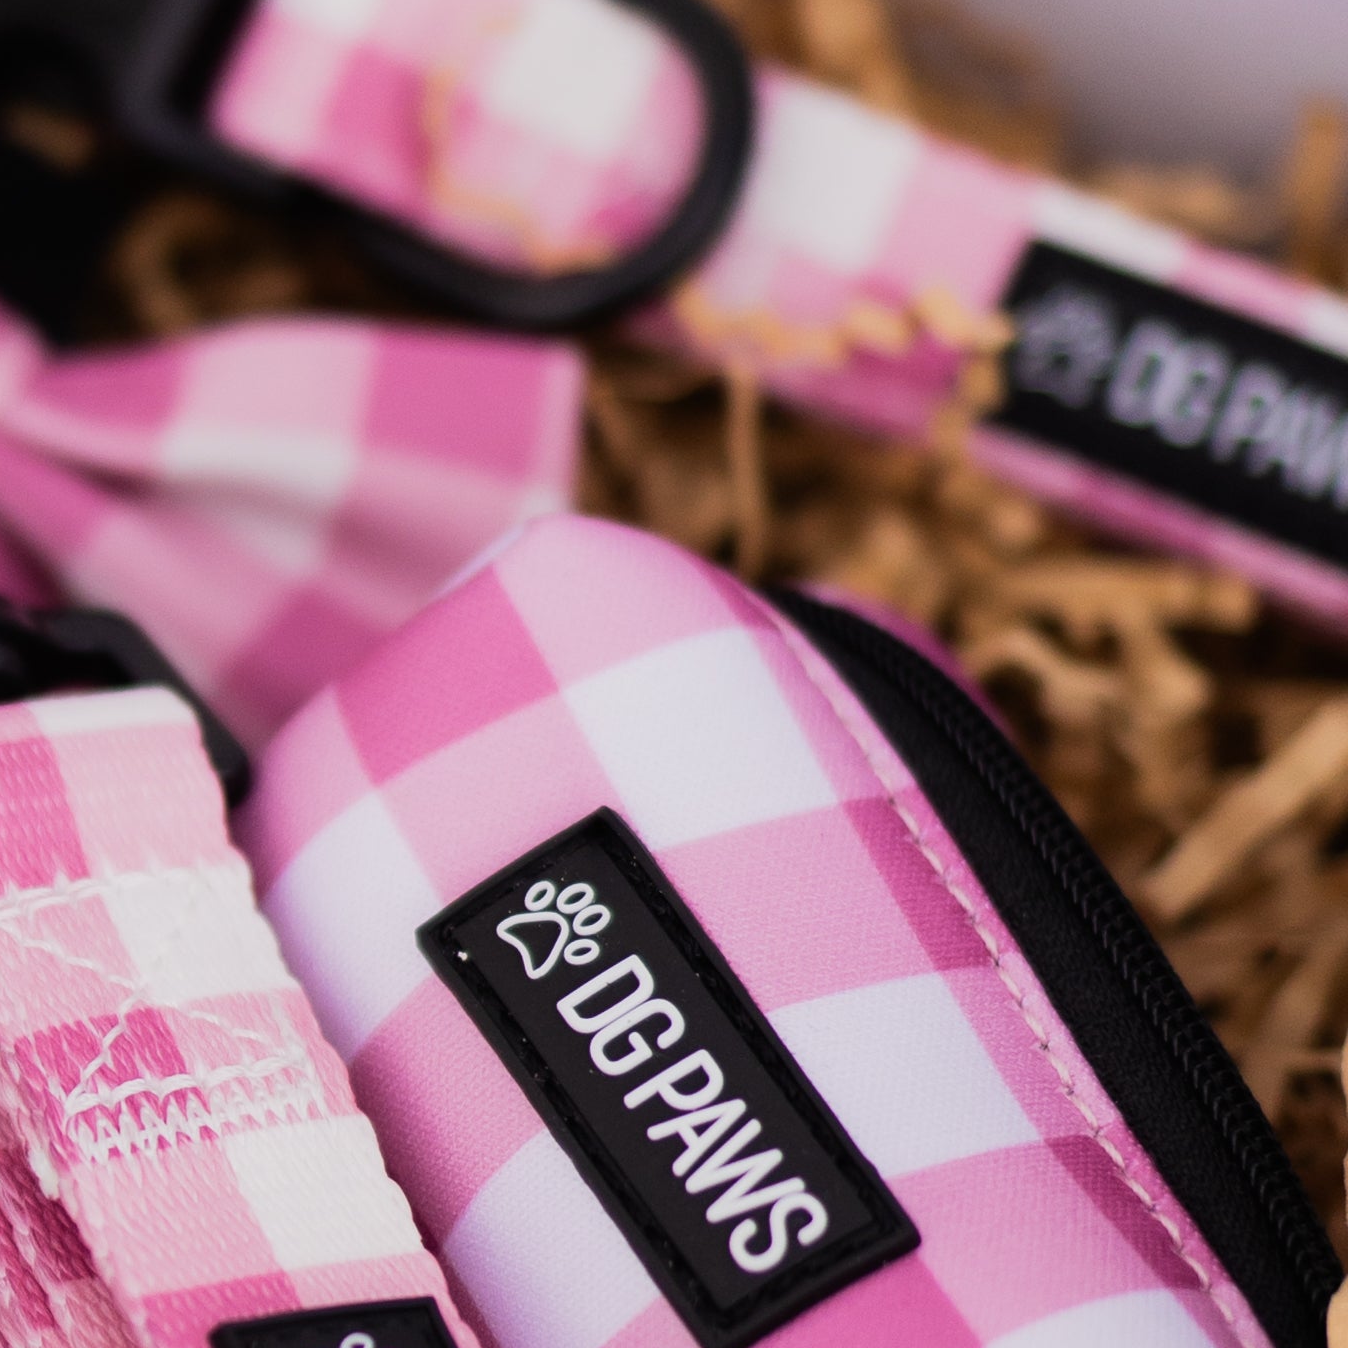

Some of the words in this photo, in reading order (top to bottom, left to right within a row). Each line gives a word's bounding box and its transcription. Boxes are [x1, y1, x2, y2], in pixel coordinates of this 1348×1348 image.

[1107, 318, 1230, 448] DG
[556, 954, 686, 1076] DG
[623, 1048, 829, 1273] PAWS
